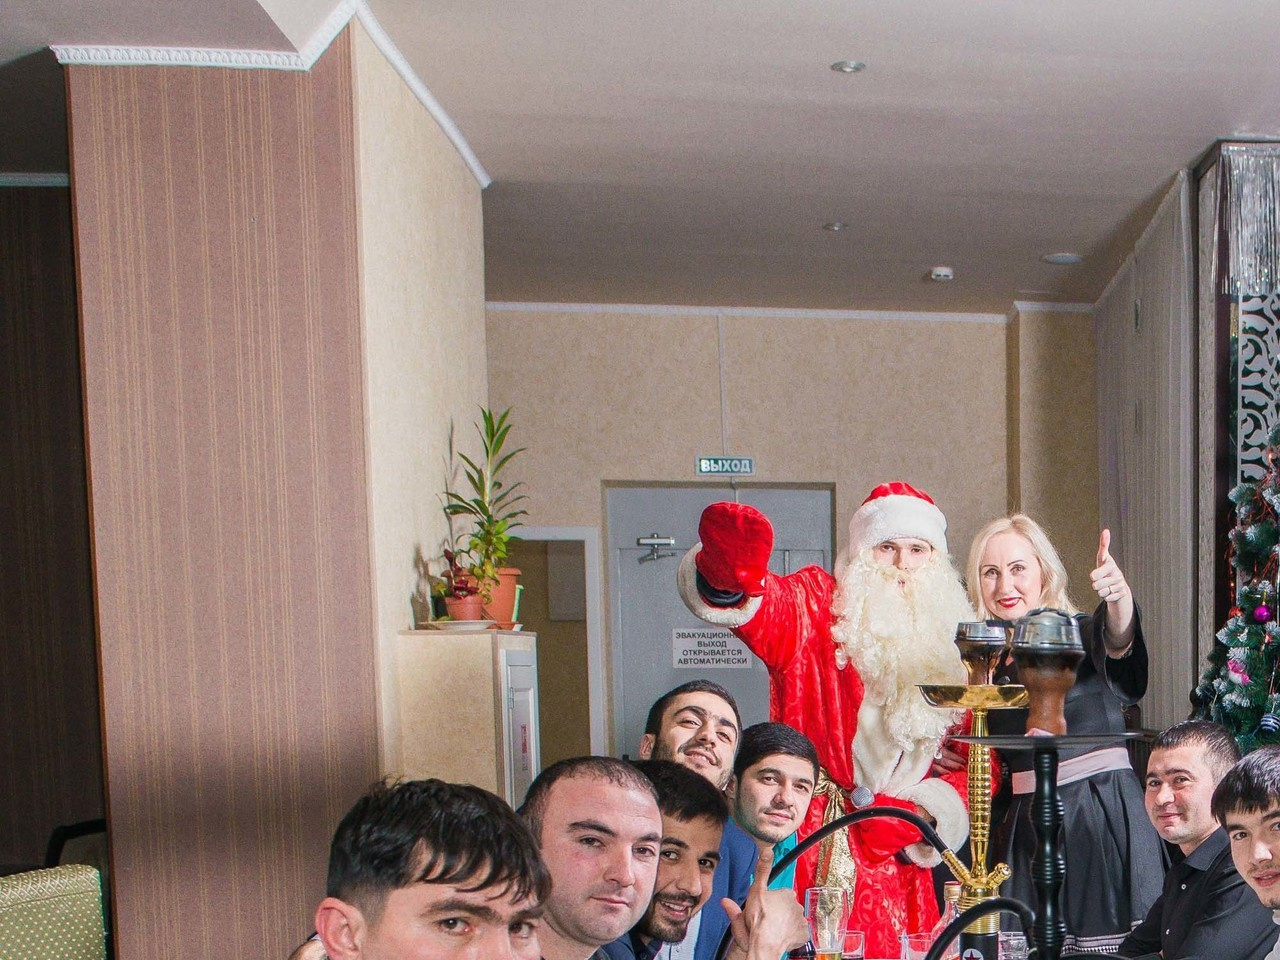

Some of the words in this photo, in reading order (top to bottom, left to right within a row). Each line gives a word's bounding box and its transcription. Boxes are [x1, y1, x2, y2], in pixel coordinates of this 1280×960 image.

[700, 459, 751, 473] ВЫХОД
[676, 632, 738, 640] ЭВАКУАЦИОНН
[697, 641, 728, 649] ВЫХОД
[682, 649, 743, 657] ОТКРЫВАЕТСЯ
[678, 658, 748, 666] АВТОМАТИЧЕСКИ
